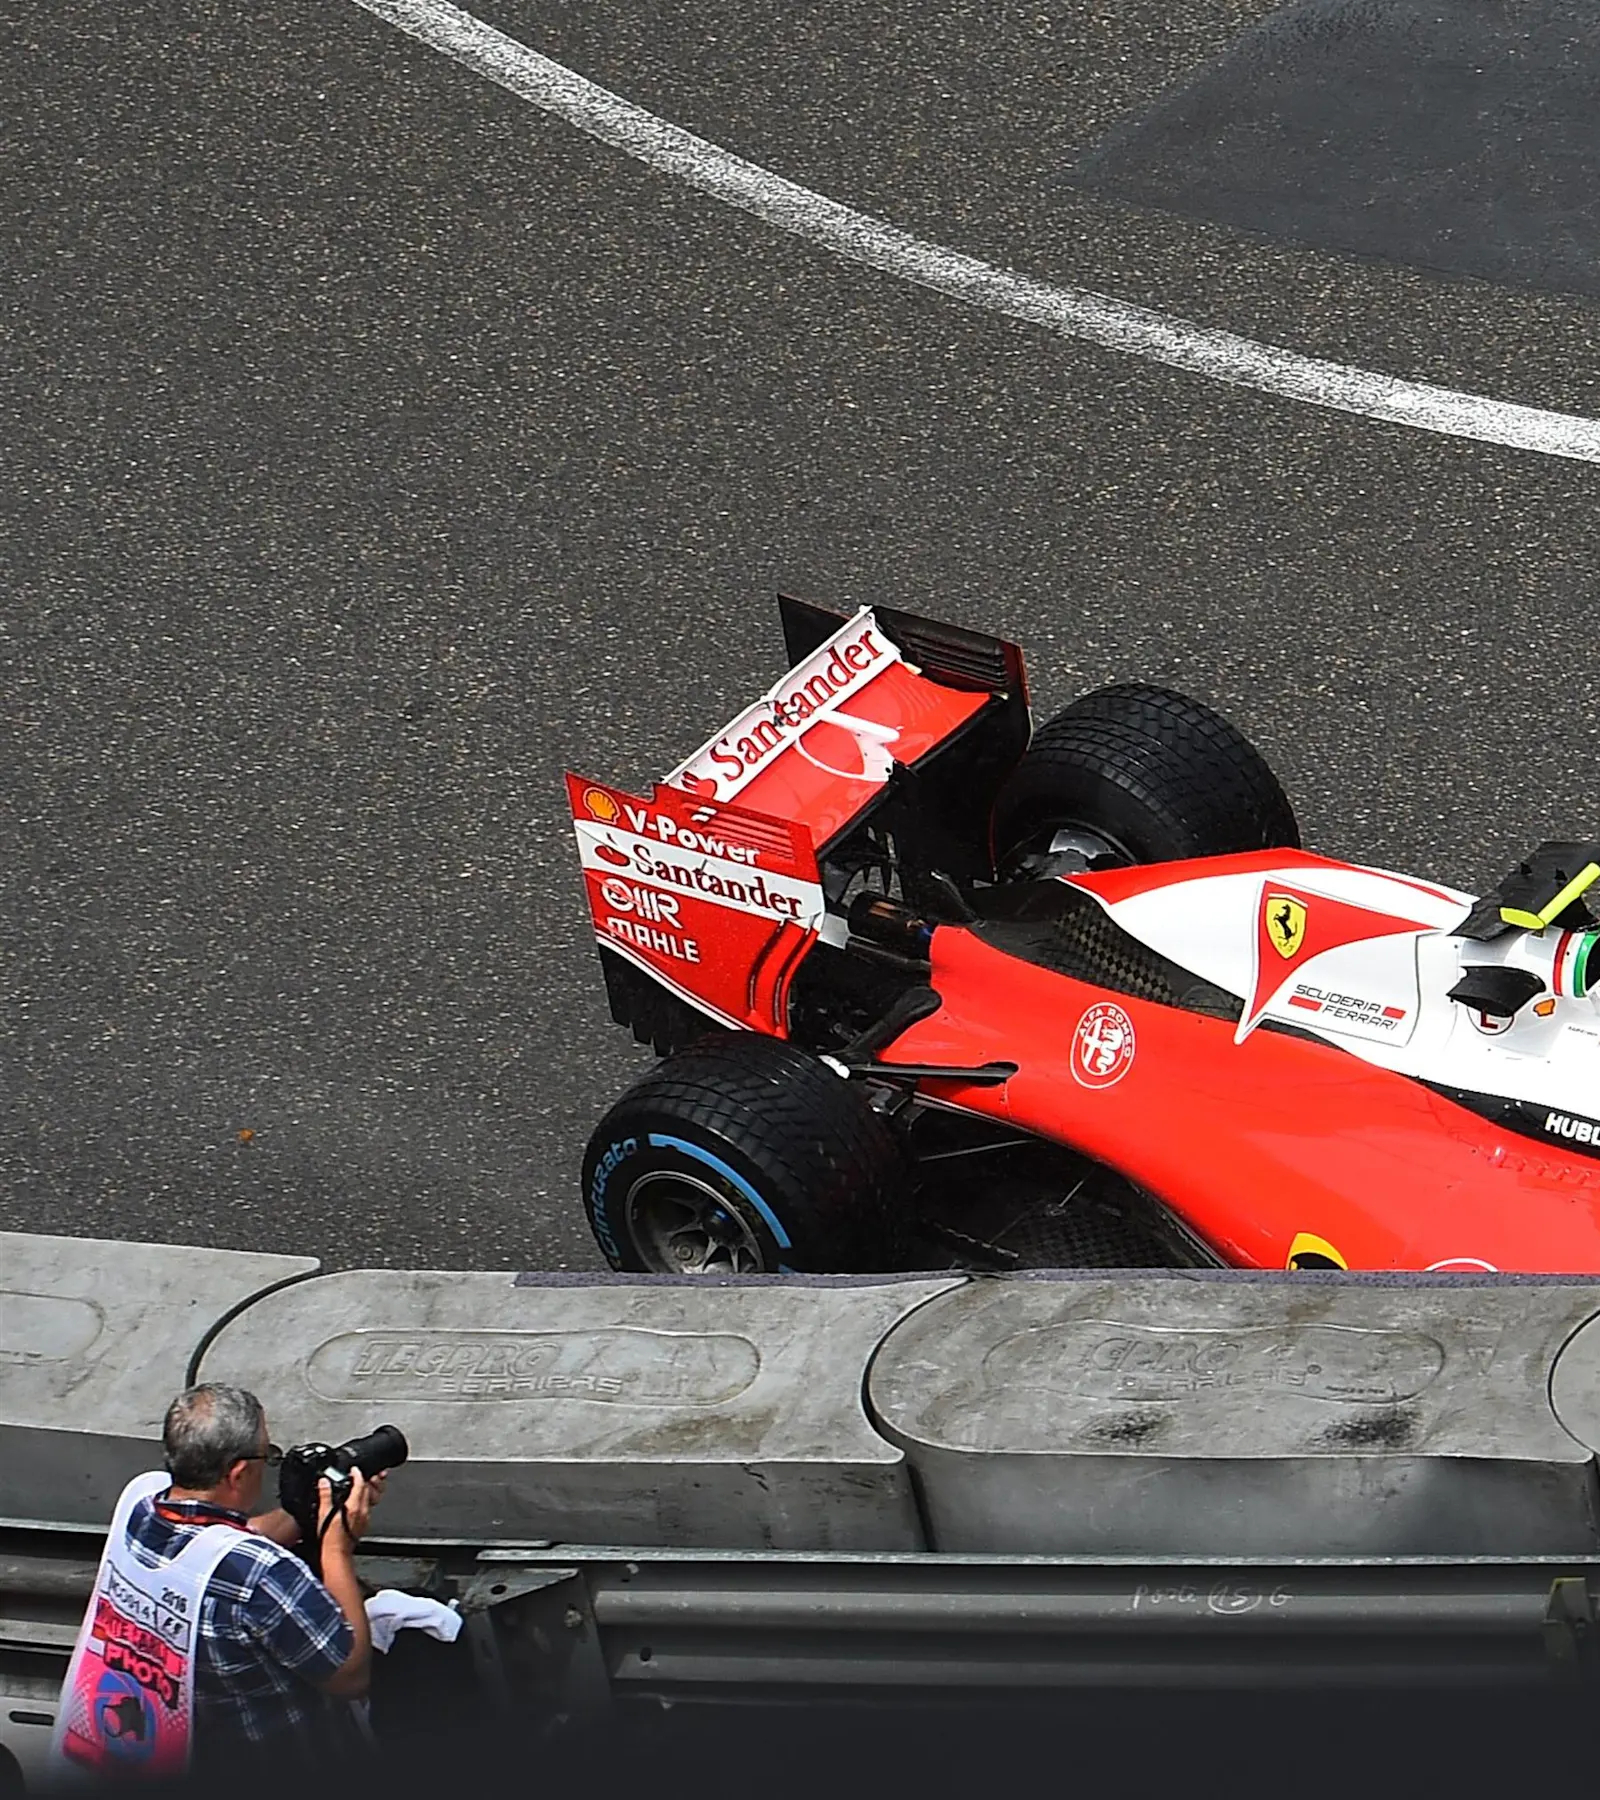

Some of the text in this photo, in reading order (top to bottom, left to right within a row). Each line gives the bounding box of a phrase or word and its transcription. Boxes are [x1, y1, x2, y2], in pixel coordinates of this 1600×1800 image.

[709, 629, 884, 782] Santander
[622, 804, 761, 865] V-Power
[632, 843, 803, 918] Santander
[606, 916, 700, 963] MAHLE
[1294, 983, 1382, 1015] SCUDERIA
[1322, 1004, 1398, 1031] FERRARI
[1079, 1007, 1132, 1058] ALFA ROMEO
